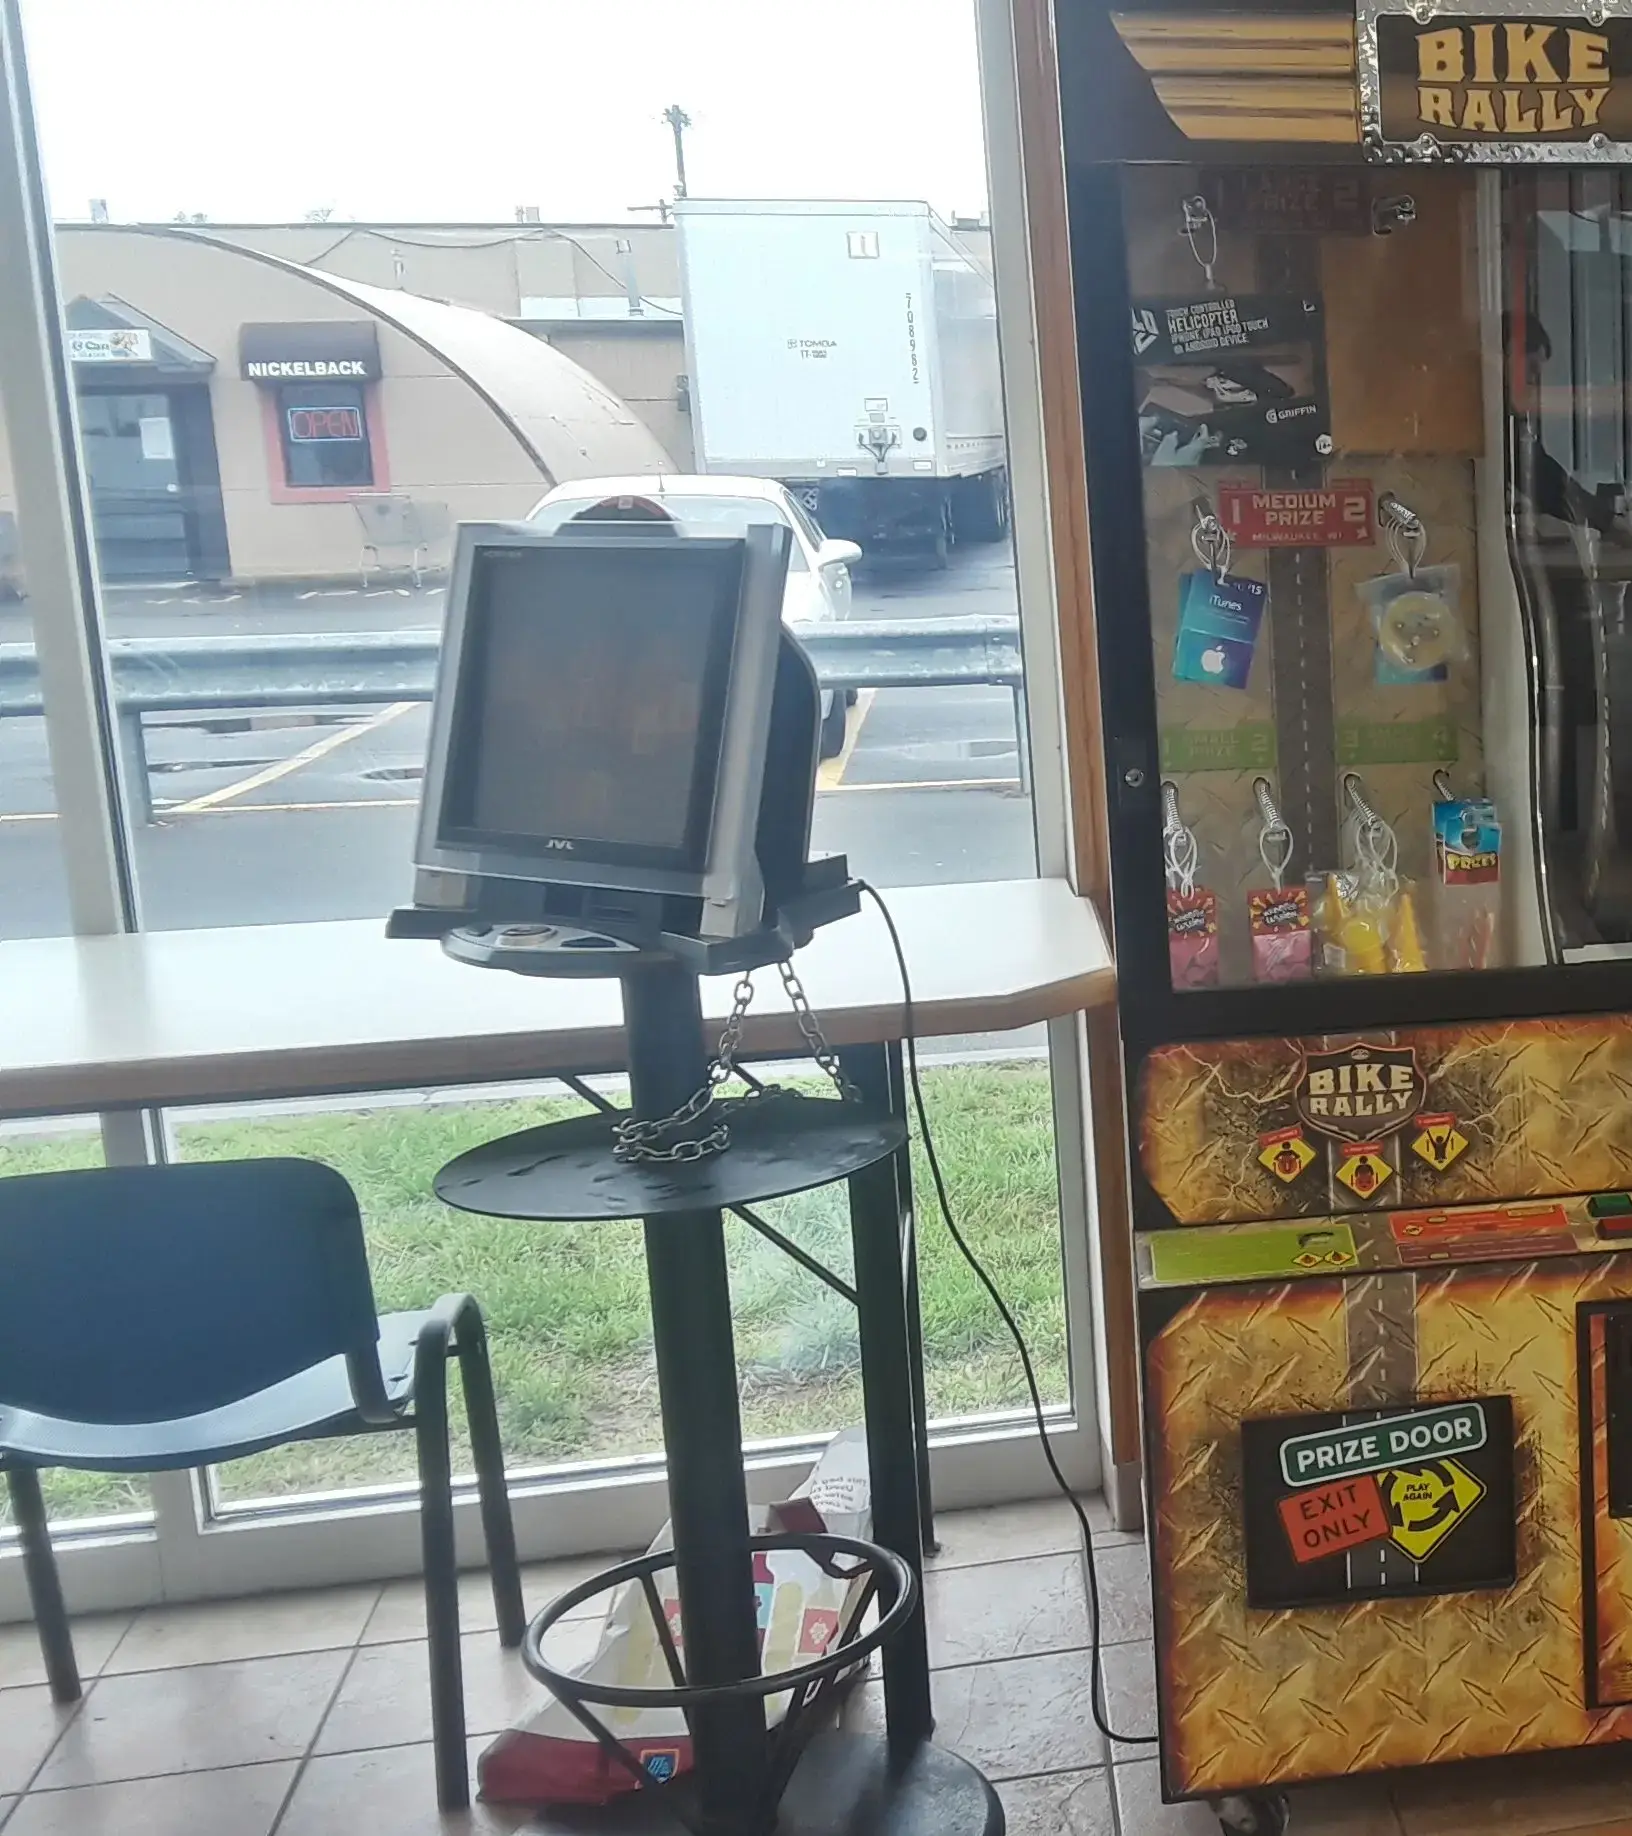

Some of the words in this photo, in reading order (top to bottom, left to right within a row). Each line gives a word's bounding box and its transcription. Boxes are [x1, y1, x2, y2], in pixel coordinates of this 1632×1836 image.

[1415, 24, 1610, 83] BIKE
[1417, 87, 1611, 133] RALLY
[1167, 309, 1238, 334] HELICOPTER
[247, 361, 367, 376] NICKELBACK
[292, 410, 359, 438] OPEN
[1278, 405, 1317, 420] GRIFFIN
[1232, 498, 1241, 525] 1
[1252, 494, 1336, 510] MEDIUM
[1343, 497, 1366, 522] 2
[1265, 510, 1325, 526] PRIZE
[1208, 594, 1242, 611] iTunes
[544, 839, 574, 850] JVL
[1308, 1063, 1414, 1095] BIKE
[1309, 1091, 1413, 1117] RALLY
[1296, 1435, 1381, 1473] PRIZE
[1389, 1415, 1473, 1454] DOOR
[1402, 1490, 1433, 1502] AGAIN
[1406, 1482, 1431, 1492] PLAY
[1300, 1484, 1357, 1520] EXIT
[1303, 1509, 1371, 1549] ONLY
